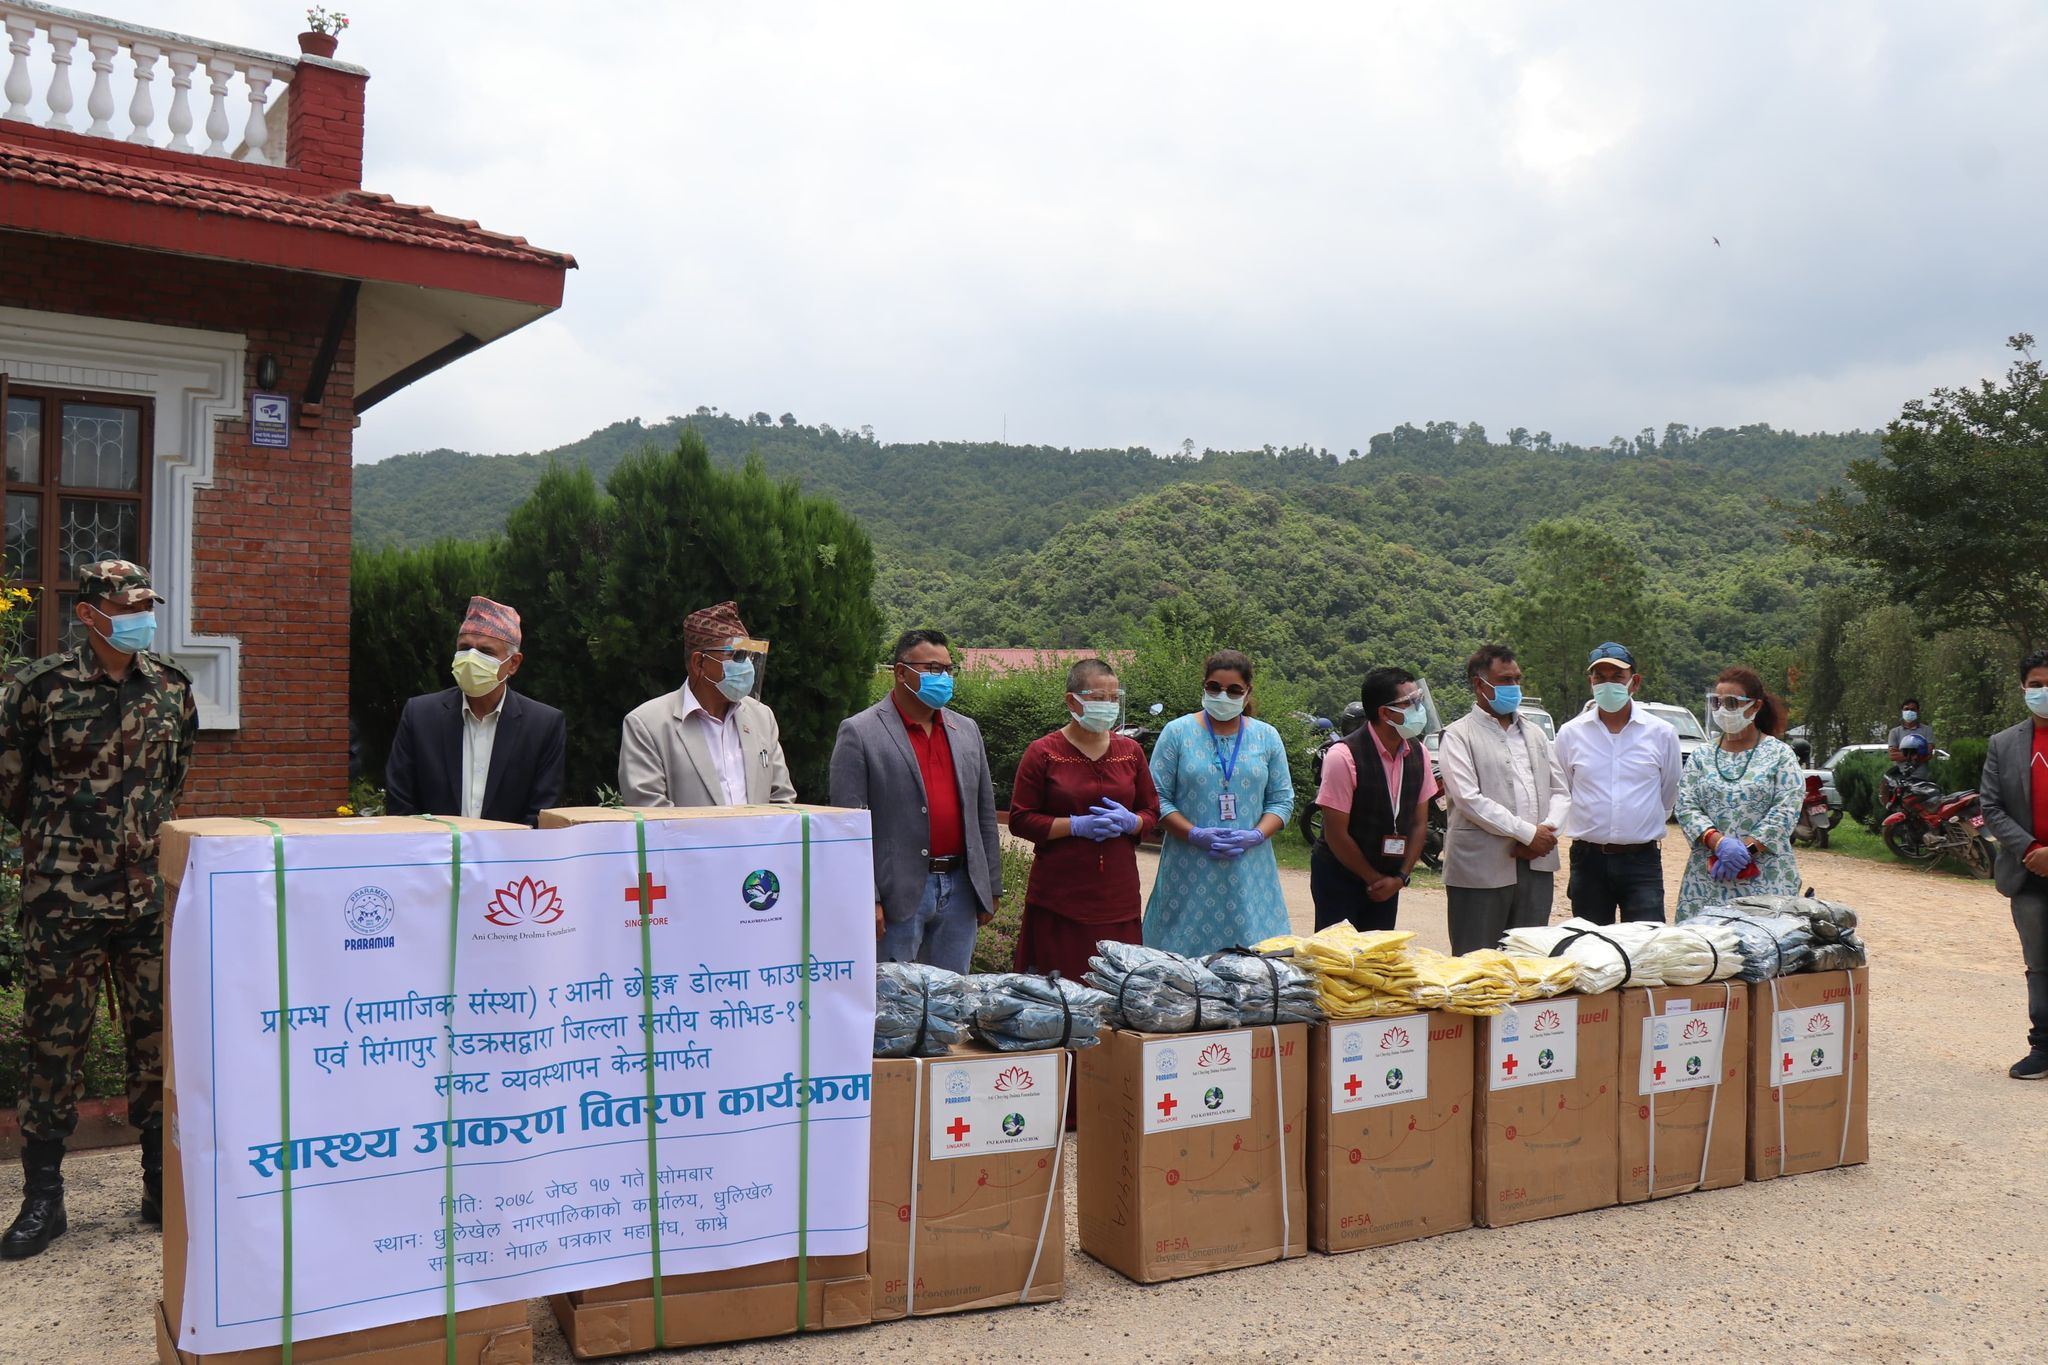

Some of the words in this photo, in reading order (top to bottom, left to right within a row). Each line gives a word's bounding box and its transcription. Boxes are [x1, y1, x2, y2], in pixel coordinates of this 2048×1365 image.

[472, 933, 486, 941] Ani
[487, 931, 518, 942] Choying
[519, 931, 546, 940] Drolma
[546, 926, 577, 937] Foundation
[624, 917, 669, 929] SINGPORE
[344, 990, 458, 1033] (सामाजिक
[468, 985, 537, 1020] संस्था)
[549, 987, 559, 1008] र
[565, 972, 614, 1003] आनी
[689, 964, 750, 994] डोल्मा
[313, 1040, 349, 1074] एवं
[359, 1035, 438, 1069] सिंगापुर
[561, 1015, 629, 1044] जिल्ला
[638, 1005, 700, 1035] स्तरीय
[1252, 1041, 1295, 1060] uwell
[434, 1070, 490, 1097] संकट
[502, 1057, 601, 1090] व्यवस्थापन
[248, 1127, 400, 1178] स्वास्थ्य
[413, 1105, 568, 1154] उपकरण
[579, 1090, 706, 1131] वितरण
[718, 1072, 872, 1116] कार्यक्रम
[495, 1190, 536, 1211] २०७८
[589, 1177, 610, 1193] १७
[620, 1168, 645, 1188] गते
[656, 1164, 714, 1185] सोमबार
[373, 1233, 423, 1254] स्थान:
[512, 1197, 621, 1233] नगरपालिकाको
[632, 1190, 704, 1214] कार्यालय,
[713, 1182, 774, 1213] धुलिखेल
[1340, 1213, 1371, 1229] 8F-5A
[428, 1250, 494, 1272] सन्वय:
[505, 1240, 548, 1261] नेपाल
[558, 1229, 612, 1250] पत्रकार
[695, 1212, 728, 1233] काभ्रे
[1156, 1237, 1190, 1253] 8F-5A
[885, 1277, 925, 1293] 8F-A
[885, 1293, 920, 1305] Oxygn
[921, 1285, 981, 1299] Concentrator
